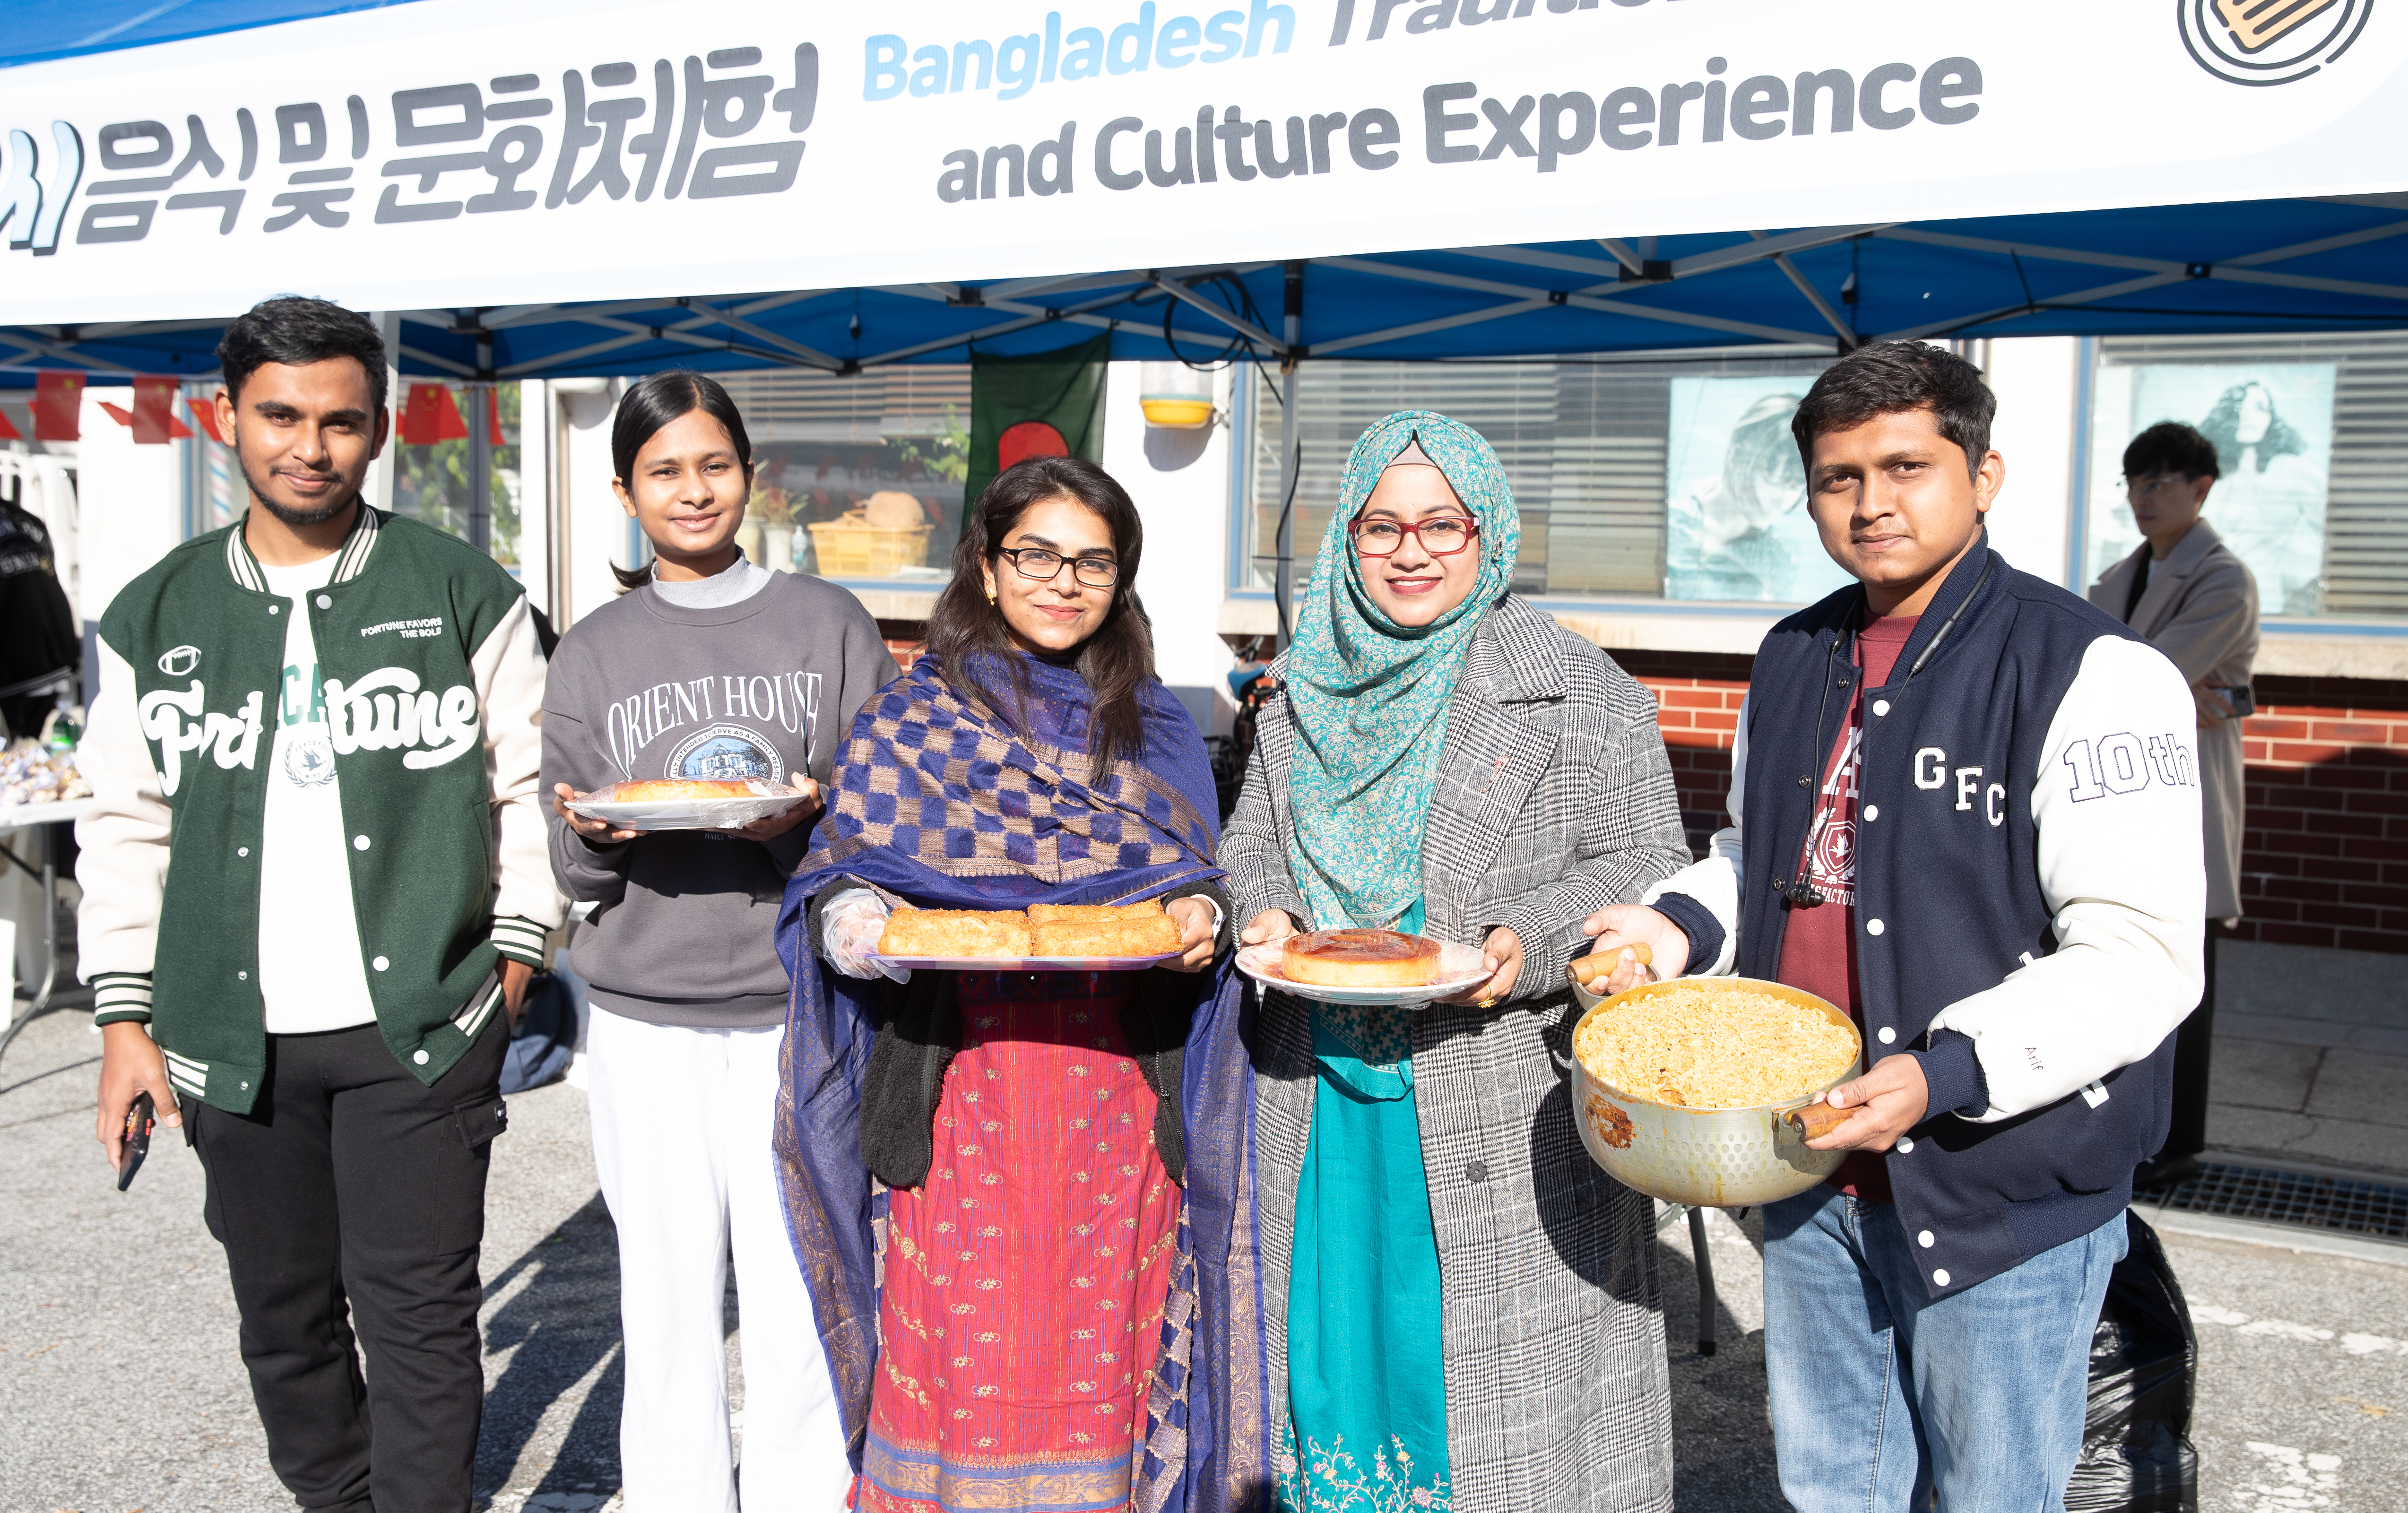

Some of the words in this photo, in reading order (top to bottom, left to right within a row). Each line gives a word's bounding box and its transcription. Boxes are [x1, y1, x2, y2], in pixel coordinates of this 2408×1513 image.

[863, 0, 1296, 101] Bangladesh
[76, 108, 258, 244] 음식
[263, 95, 369, 233] 및
[374, 42, 819, 224] 문화체험
[937, 121, 1076, 203] and
[1095, 105, 1400, 190] Culture
[1423, 57, 1983, 173] Experience
[361, 621, 407, 637] FORTUNE
[406, 617, 442, 629] FAVORS
[399, 629, 418, 639] THE
[419, 627, 442, 637] BOLD
[607, 676, 714, 779] ORIENT
[723, 671, 822, 765] HOUSE
[676, 737, 703, 761] INTENDED
[751, 736, 773, 755] FAMILY
[2062, 731, 2195, 803] 10th
[2025, 1047, 2044, 1071] Arif
